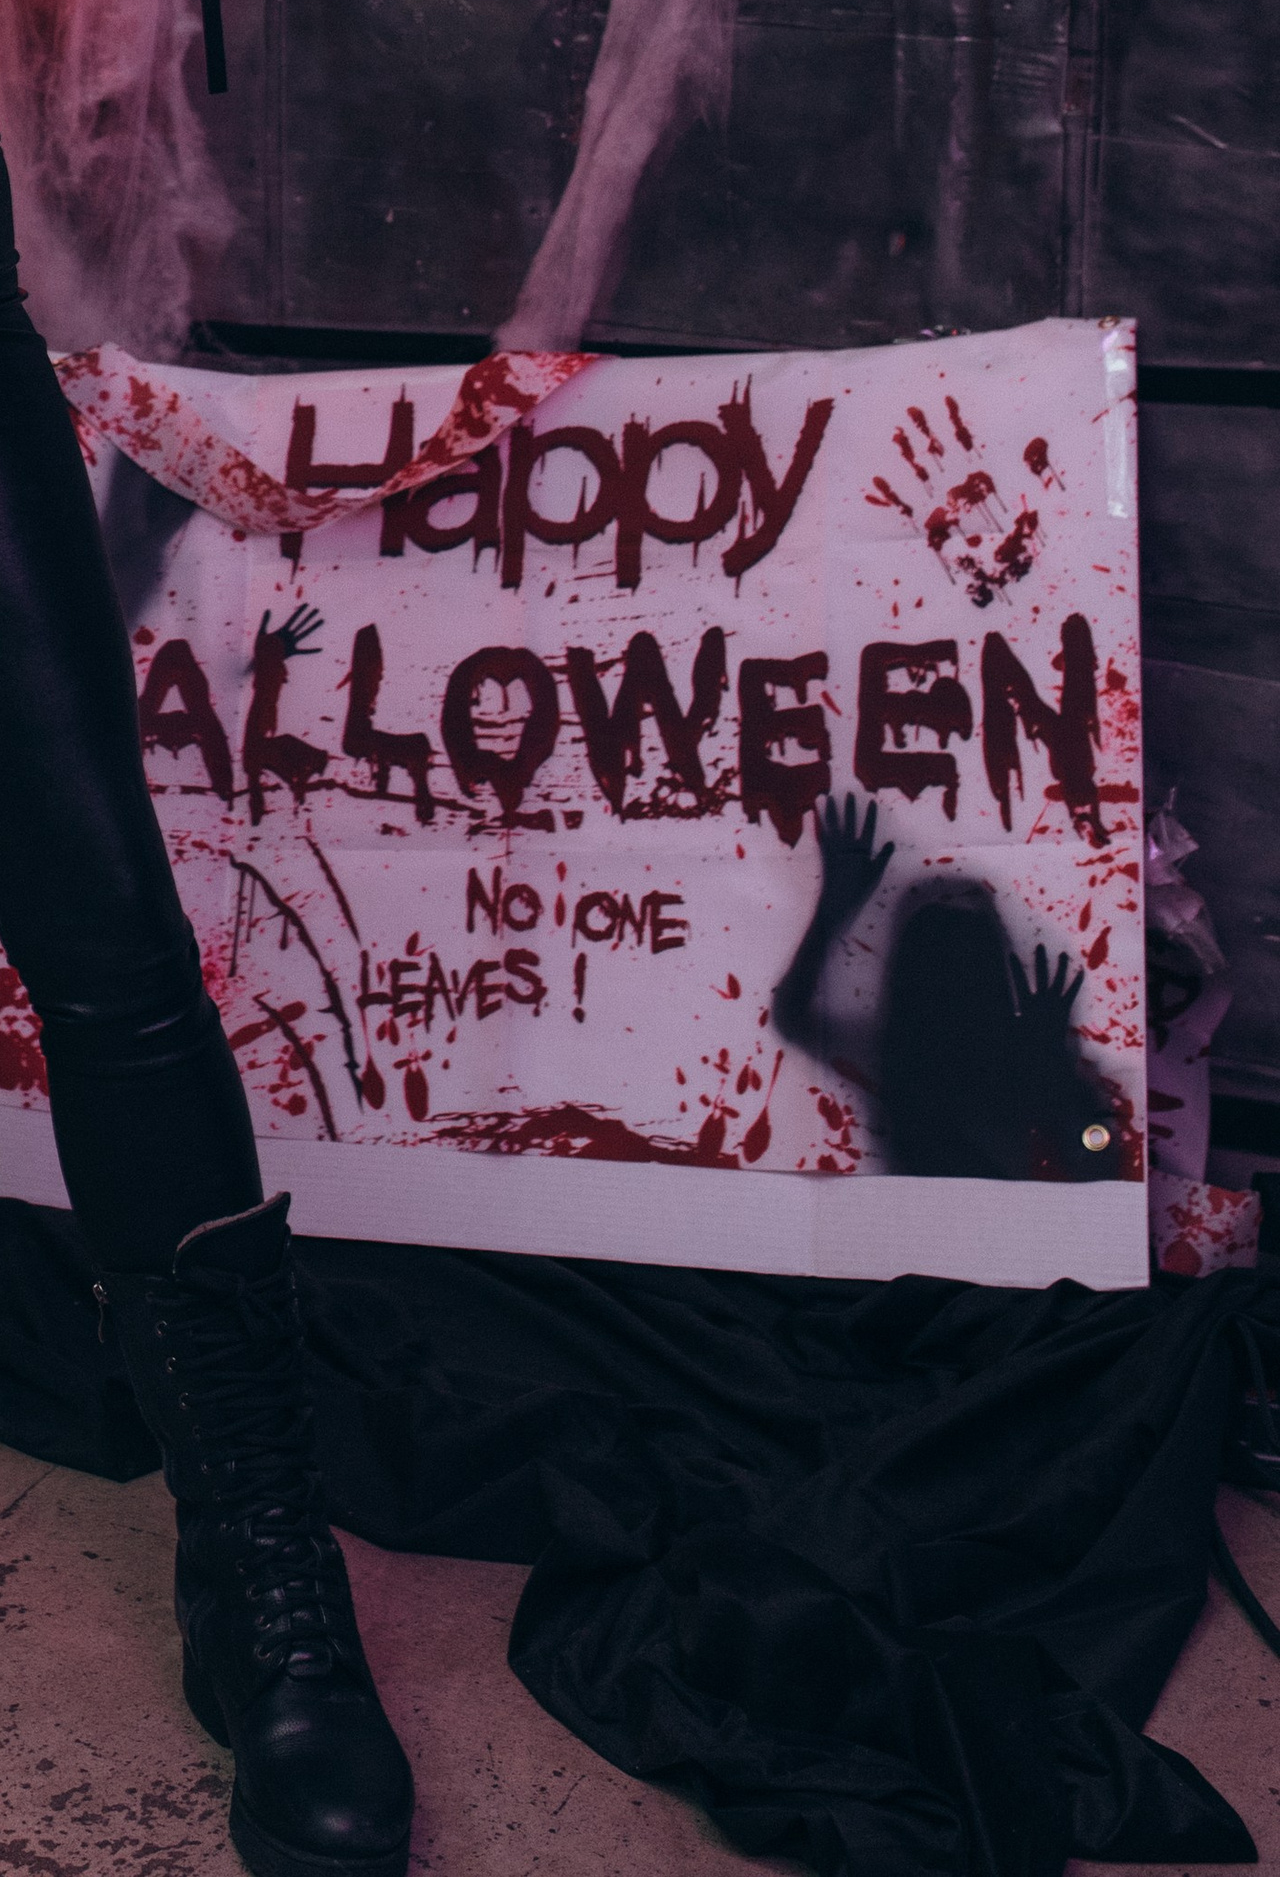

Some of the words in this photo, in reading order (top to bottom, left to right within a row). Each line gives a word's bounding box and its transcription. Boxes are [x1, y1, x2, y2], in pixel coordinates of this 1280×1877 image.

[281, 379, 834, 595] Happy
[139, 613, 1110, 847] ALLOWEEN
[467, 866, 543, 934] NO
[572, 890, 690, 954] ONE
